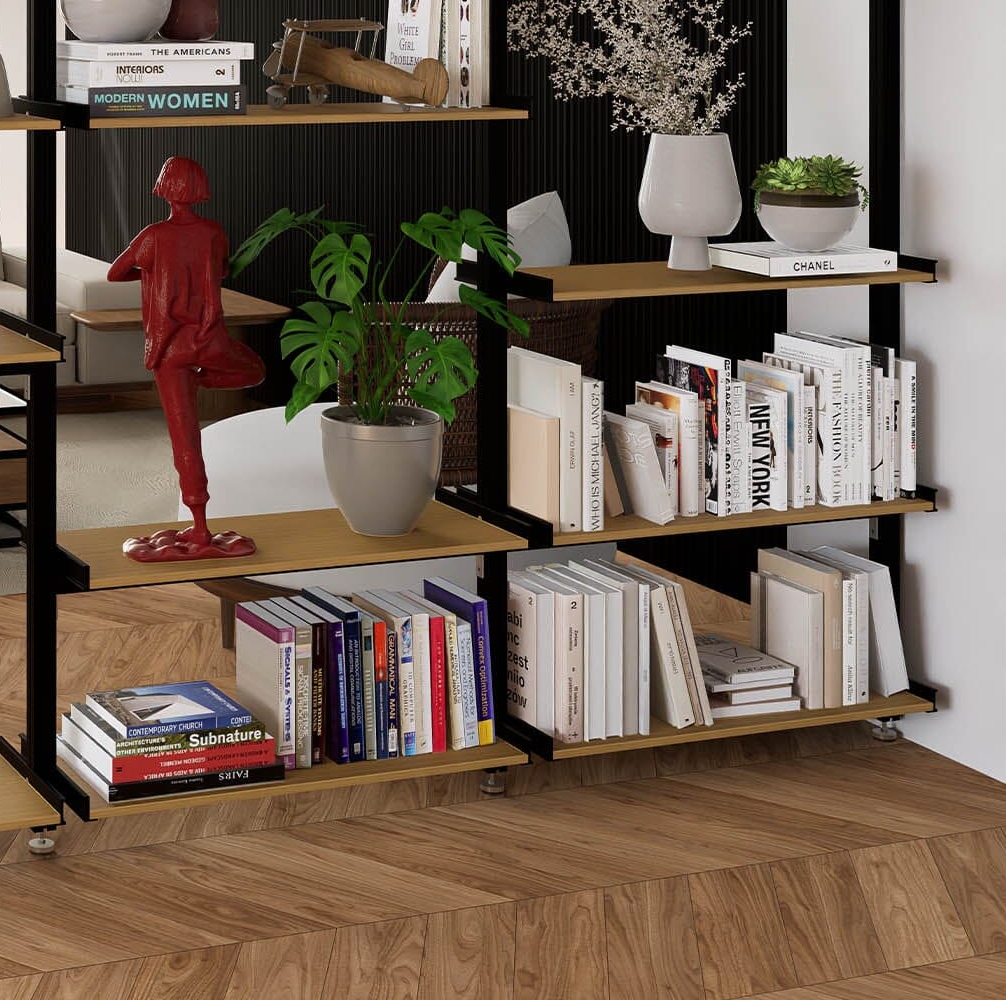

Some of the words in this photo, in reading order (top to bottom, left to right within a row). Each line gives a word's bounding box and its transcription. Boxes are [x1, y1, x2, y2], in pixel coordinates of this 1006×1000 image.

[397, 23, 419, 36] WHITE
[151, 48, 170, 56] THE
[173, 48, 231, 56] AMERICANS
[399, 38, 415, 51] GIRL
[116, 65, 164, 74] INTERIORS
[215, 68, 226, 76] 2
[94, 93, 145, 104] MODERN
[147, 92, 229, 110] WOMEN
[793, 261, 835, 272] CHANEL
[831, 370, 842, 400] THE
[732, 385, 743, 417] Elliott
[857, 402, 863, 412] OF
[911, 405, 916, 414] IN
[591, 393, 601, 430] JANG?
[750, 405, 771, 448] NEW
[831, 402, 842, 462] FASHION
[732, 421, 743, 454] Erwitt
[591, 431, 600, 484] MICHAEL
[752, 455, 771, 507] YORK
[831, 465, 842, 504] BOOK
[591, 486, 600, 498] IS
[591, 500, 600, 531] WHO
[528, 596, 533, 606] 2
[571, 601, 577, 610] 2
[353, 639, 359, 650] AN
[477, 635, 486, 665] Convex
[284, 646, 292, 688] SIGNALS
[507, 650, 529, 671] zest
[355, 692, 361, 701] TO
[467, 673, 475, 705] Methods
[479, 666, 489, 717] Optimization
[461, 684, 470, 719] Engineers
[506, 688, 527, 708] zów
[230, 715, 252, 725] CONTE
[284, 697, 292, 742] SYSTEMS
[128, 724, 177, 738] CONTEMPORARY
[178, 721, 203, 733] CHURCH
[188, 728, 262, 748] Subnature
[116, 747, 136, 757] OTHER
[137, 742, 181, 755] ENVIRONMENTS
[183, 756, 206, 764] GIDEON
[143, 772, 165, 781] AFRICA
[173, 769, 188, 777] AIDS
[218, 769, 249, 781] FAIRS
